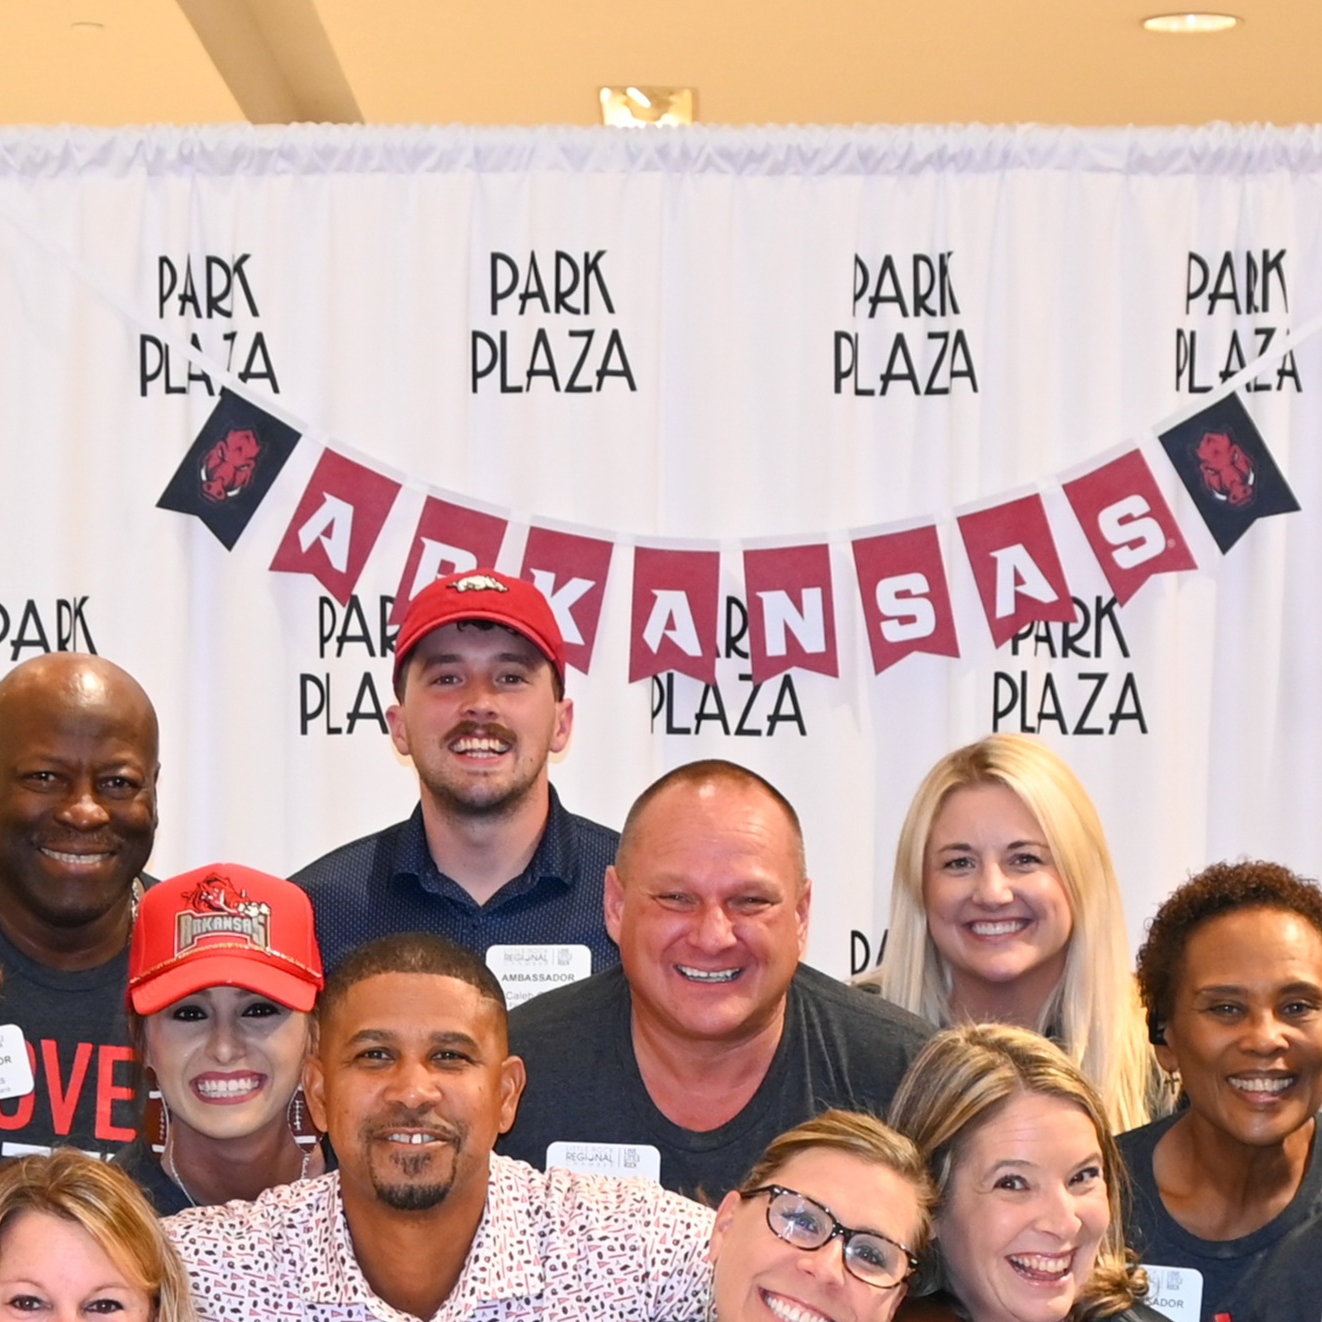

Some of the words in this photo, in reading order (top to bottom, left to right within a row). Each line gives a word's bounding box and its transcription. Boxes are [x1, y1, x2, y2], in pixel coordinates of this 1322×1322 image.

[158, 253, 260, 319] PARK
[490, 250, 615, 316] PARK
[853, 251, 960, 318] PARK
[1186, 249, 1287, 316] PARK
[471, 328, 637, 394] PLAZA
[834, 329, 978, 397] PLAZA
[1175, 327, 1303, 394] PLAZA
[300, 672, 389, 736] PLA
[651, 672, 807, 737] PLAZA
[992, 670, 1148, 736] PLAZA
[179, 913, 267, 950] ARKANSAS
[502, 973, 575, 982] AMBASSADOR
